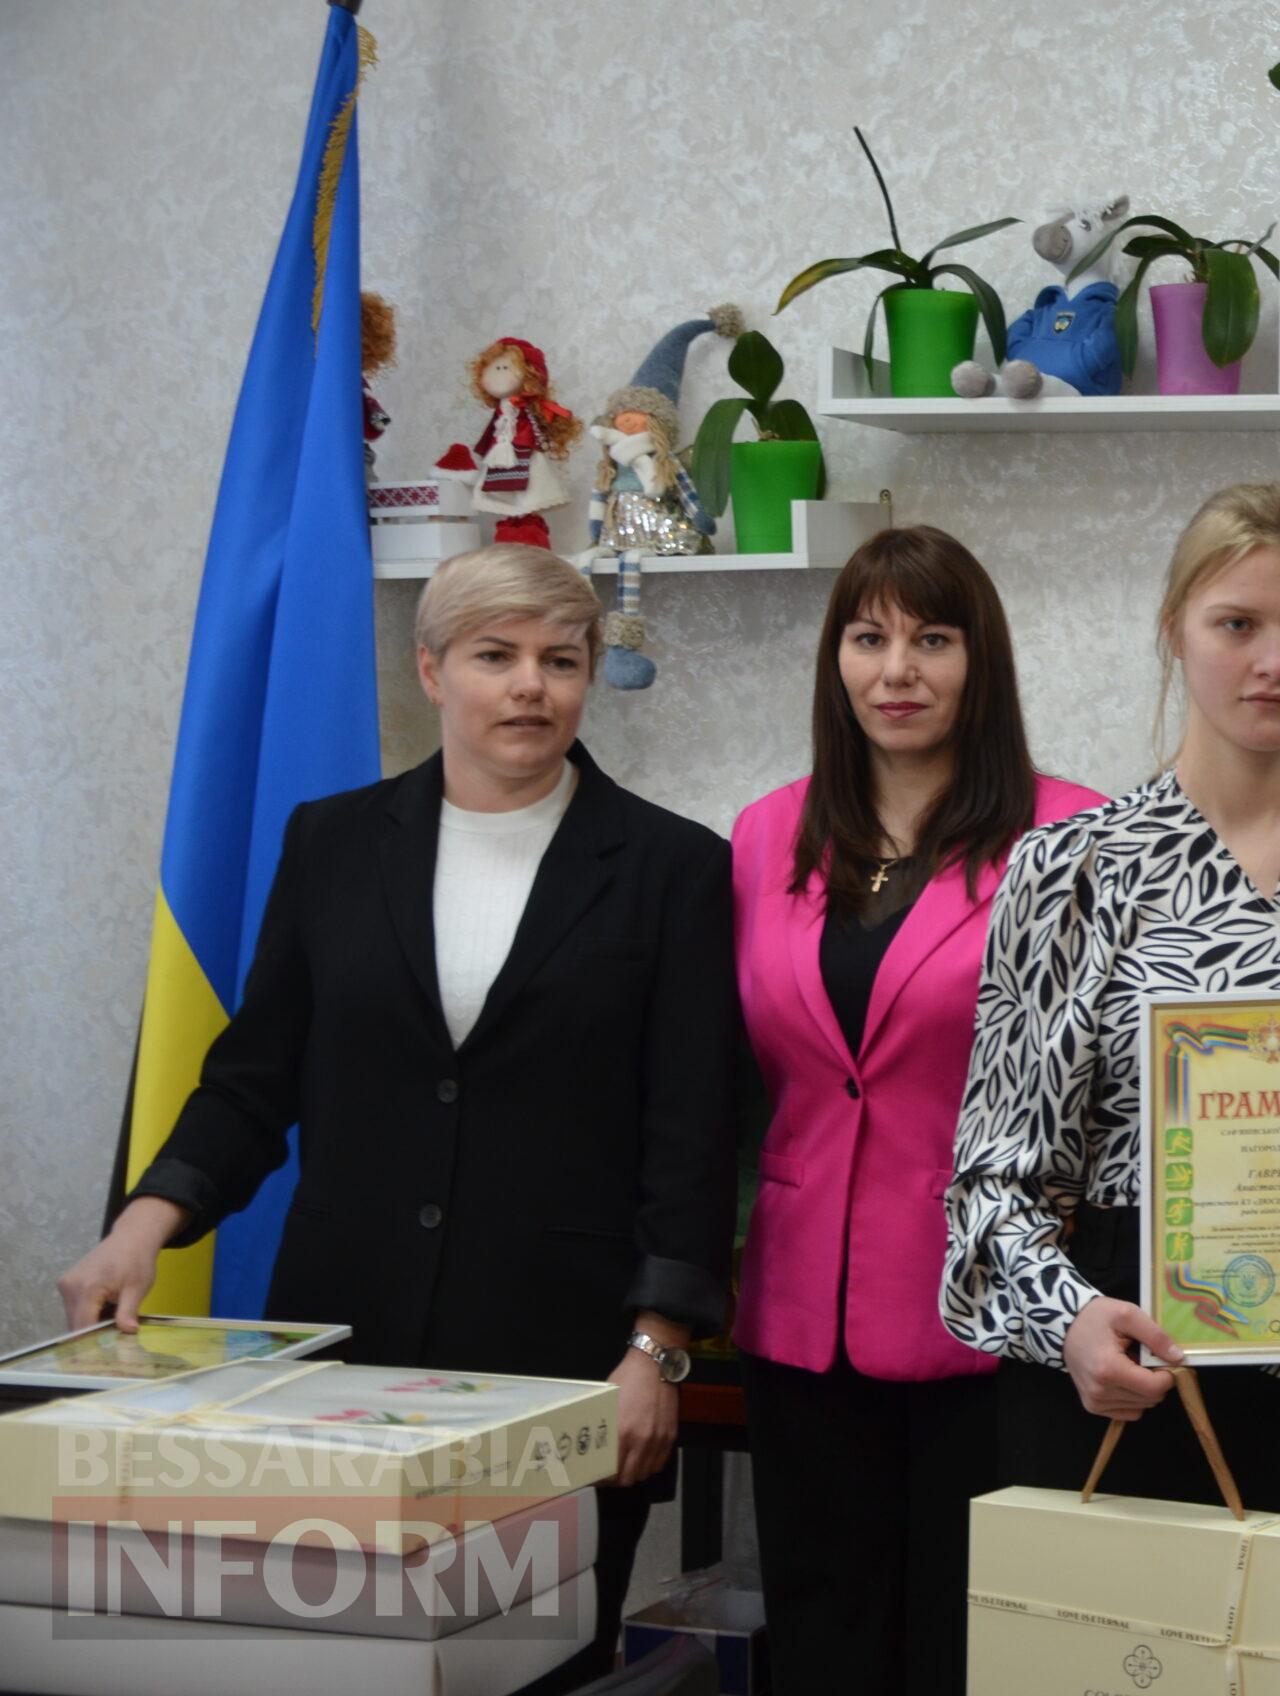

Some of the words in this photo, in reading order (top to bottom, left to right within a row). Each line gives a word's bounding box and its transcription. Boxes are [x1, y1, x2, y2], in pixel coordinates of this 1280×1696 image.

[1056, 1609, 1081, 1621] LOVE
[1090, 1615, 1130, 1629] ETERNAL
[1160, 1628, 1184, 1639] LOVE
